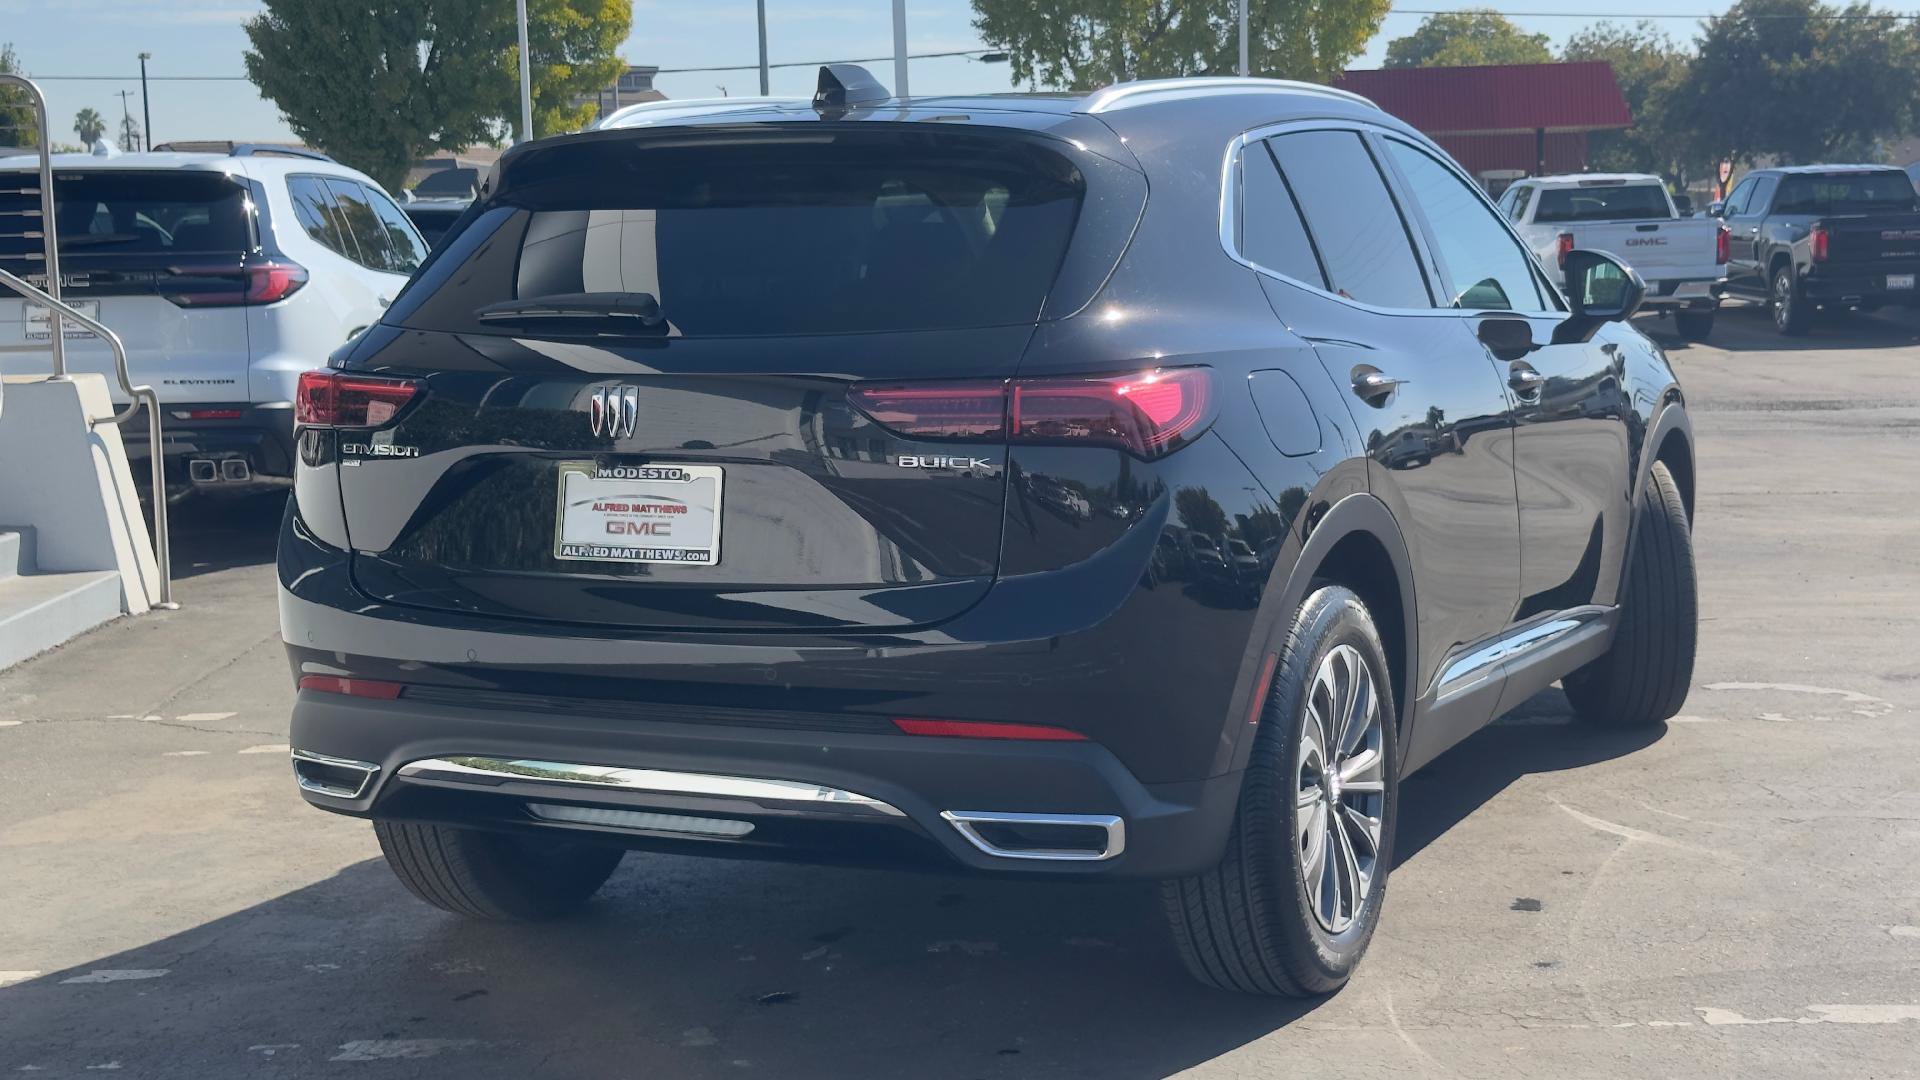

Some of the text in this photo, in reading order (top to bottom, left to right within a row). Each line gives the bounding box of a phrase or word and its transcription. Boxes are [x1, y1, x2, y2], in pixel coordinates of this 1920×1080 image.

[1625, 238, 1668, 247] GMC
[342, 443, 419, 457] ENVISION
[898, 455, 991, 469] BUICK
[598, 468, 681, 480] MODESTO
[592, 503, 688, 514] ALFRED MATTHEWS
[606, 521, 672, 537] GMC
